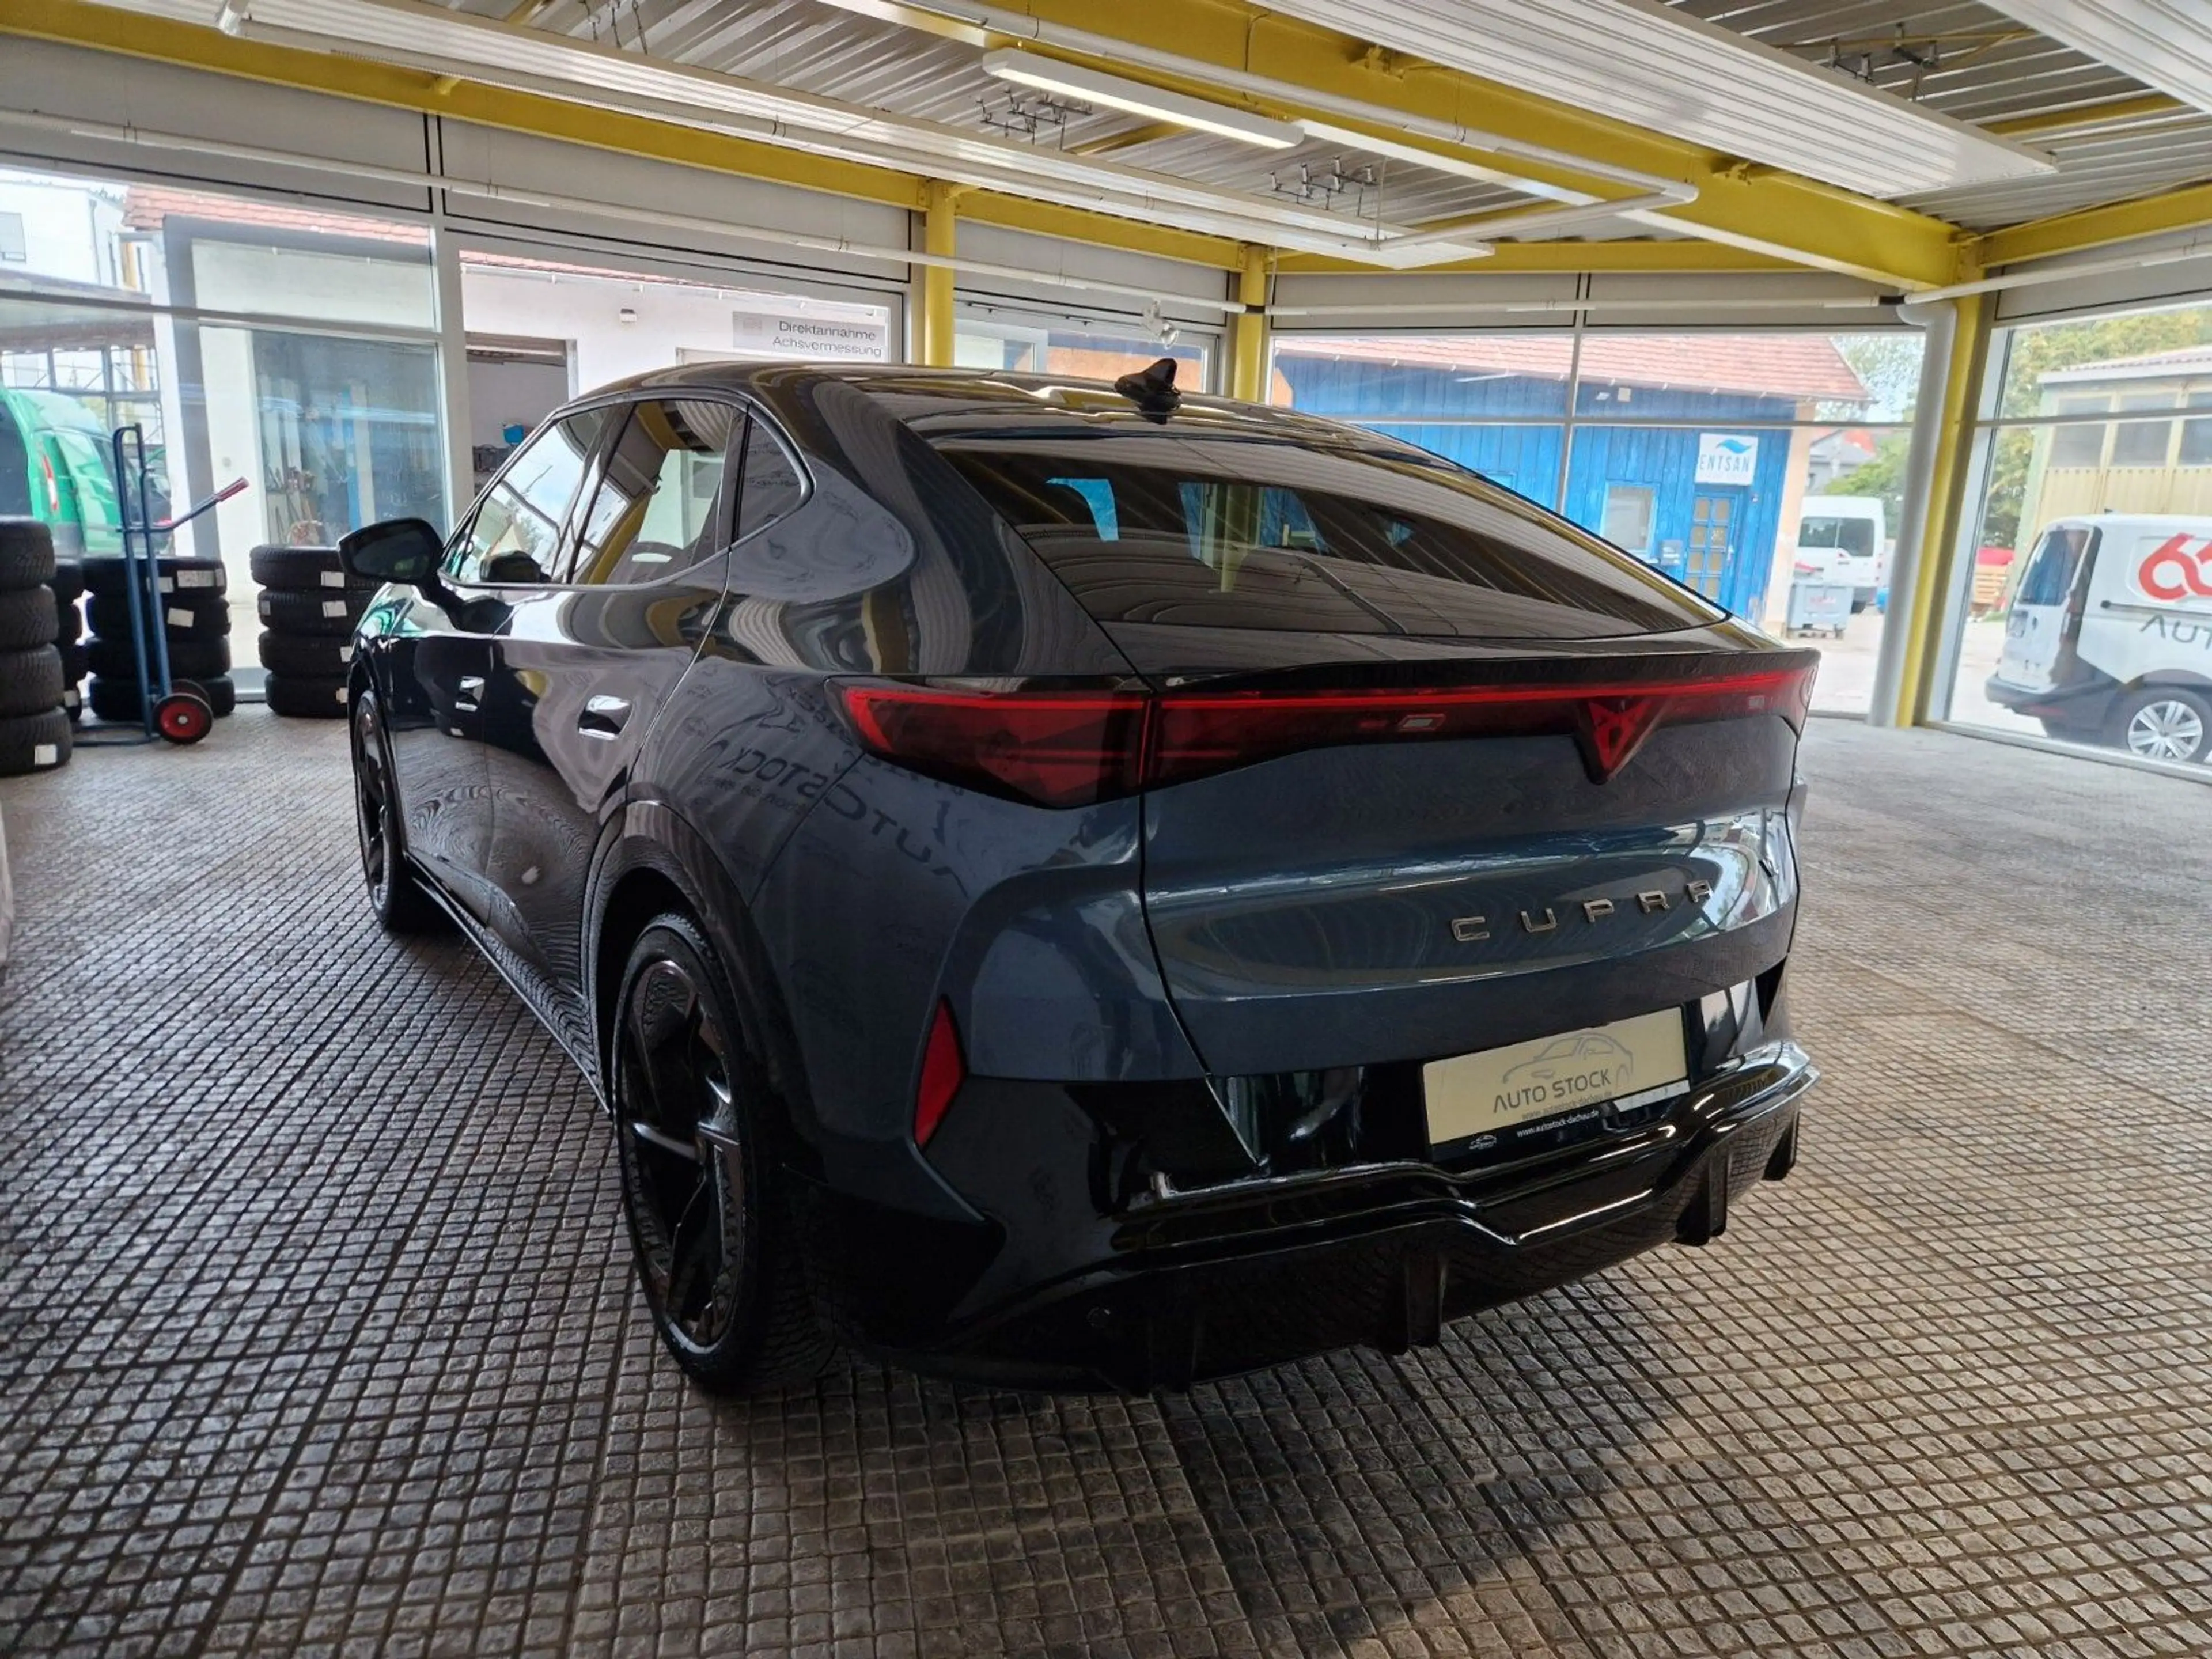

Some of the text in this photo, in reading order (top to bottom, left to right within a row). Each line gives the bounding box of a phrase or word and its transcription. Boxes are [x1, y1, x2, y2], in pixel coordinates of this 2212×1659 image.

[779, 320, 876, 341] Direktannahme
[772, 336, 882, 358] Achsvermessung
[1700, 454, 1750, 472] ENTSAN
[1452, 879, 1713, 941] CUPRA
[1493, 1069, 1611, 1113] AUTO STOCK
